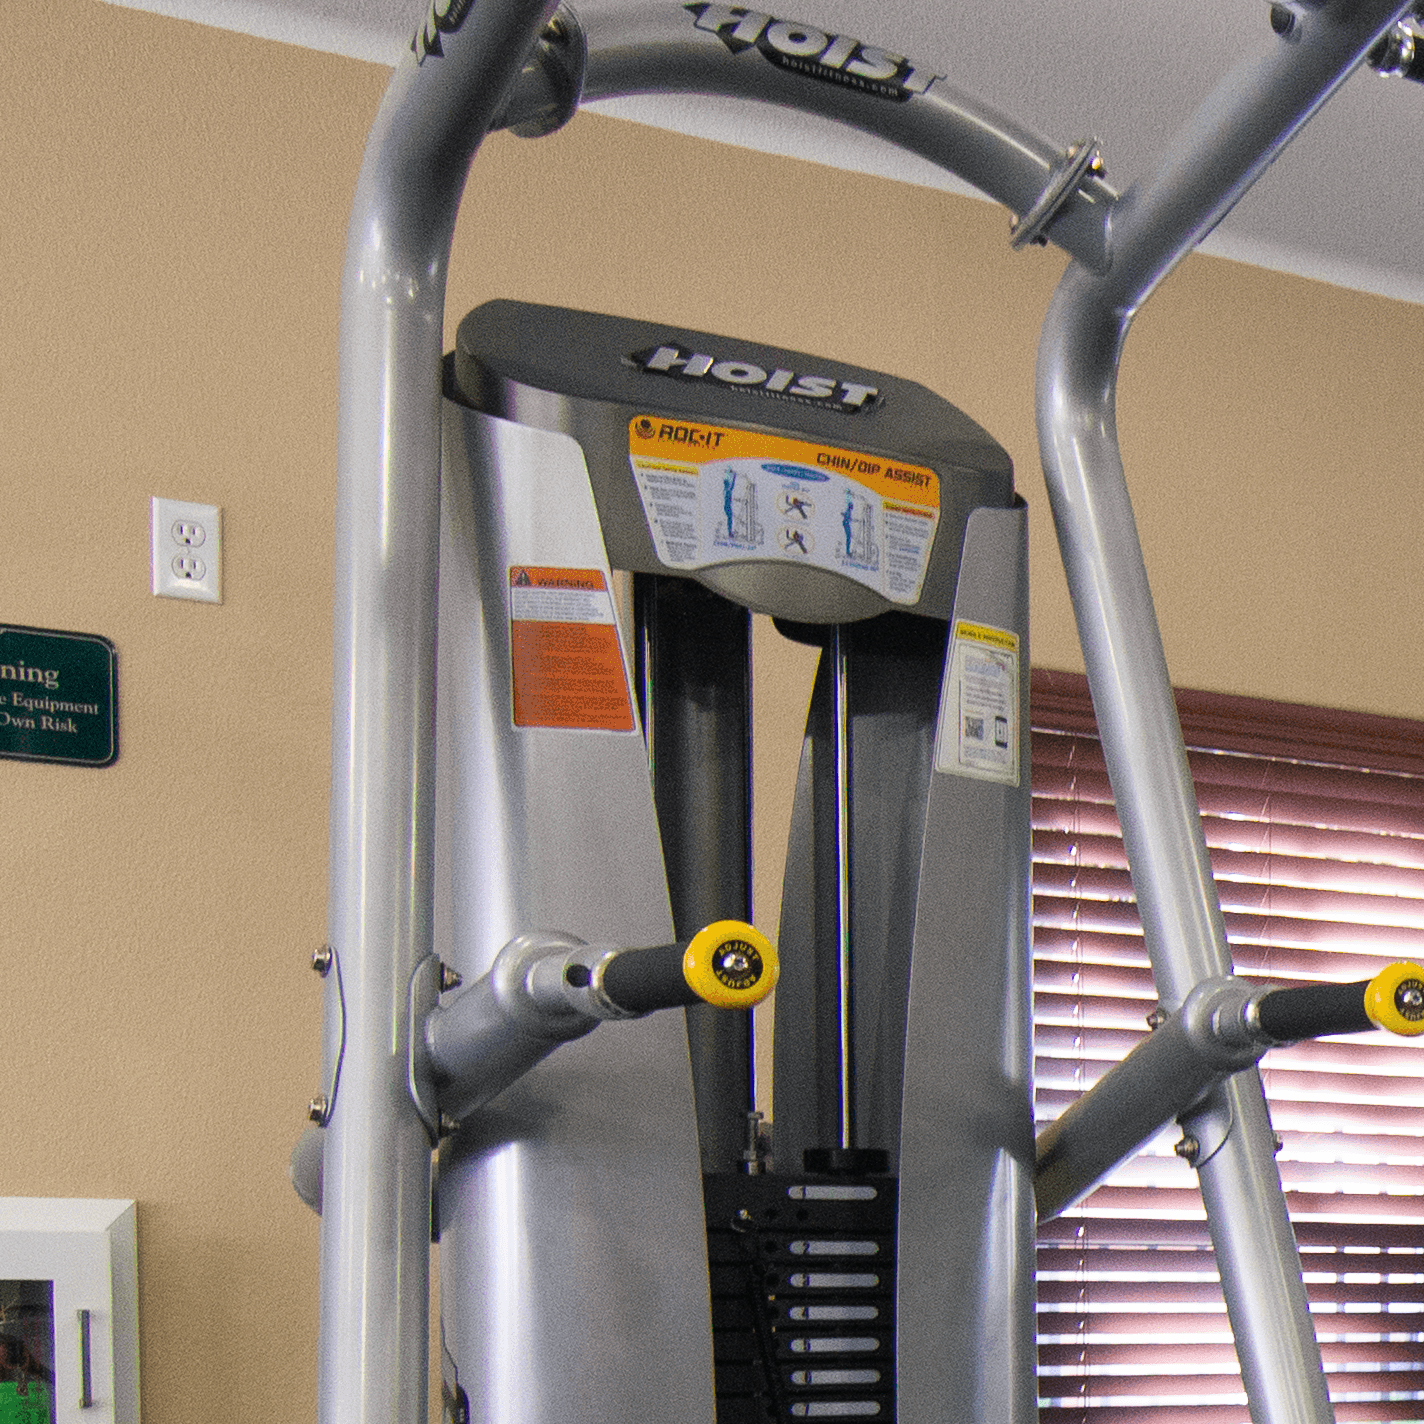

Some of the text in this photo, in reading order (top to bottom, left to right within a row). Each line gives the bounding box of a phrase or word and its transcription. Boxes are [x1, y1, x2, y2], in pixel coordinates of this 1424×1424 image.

[694, 3, 938, 94] HOIST
[647, 346, 879, 407] HOIST
[816, 452, 882, 475] CHIN/DIP
[884, 467, 933, 488] ASSIST
[11, 691, 99, 715] Equipment
[41, 714, 78, 734] Risk
[718, 942, 759, 961] ADJUST
